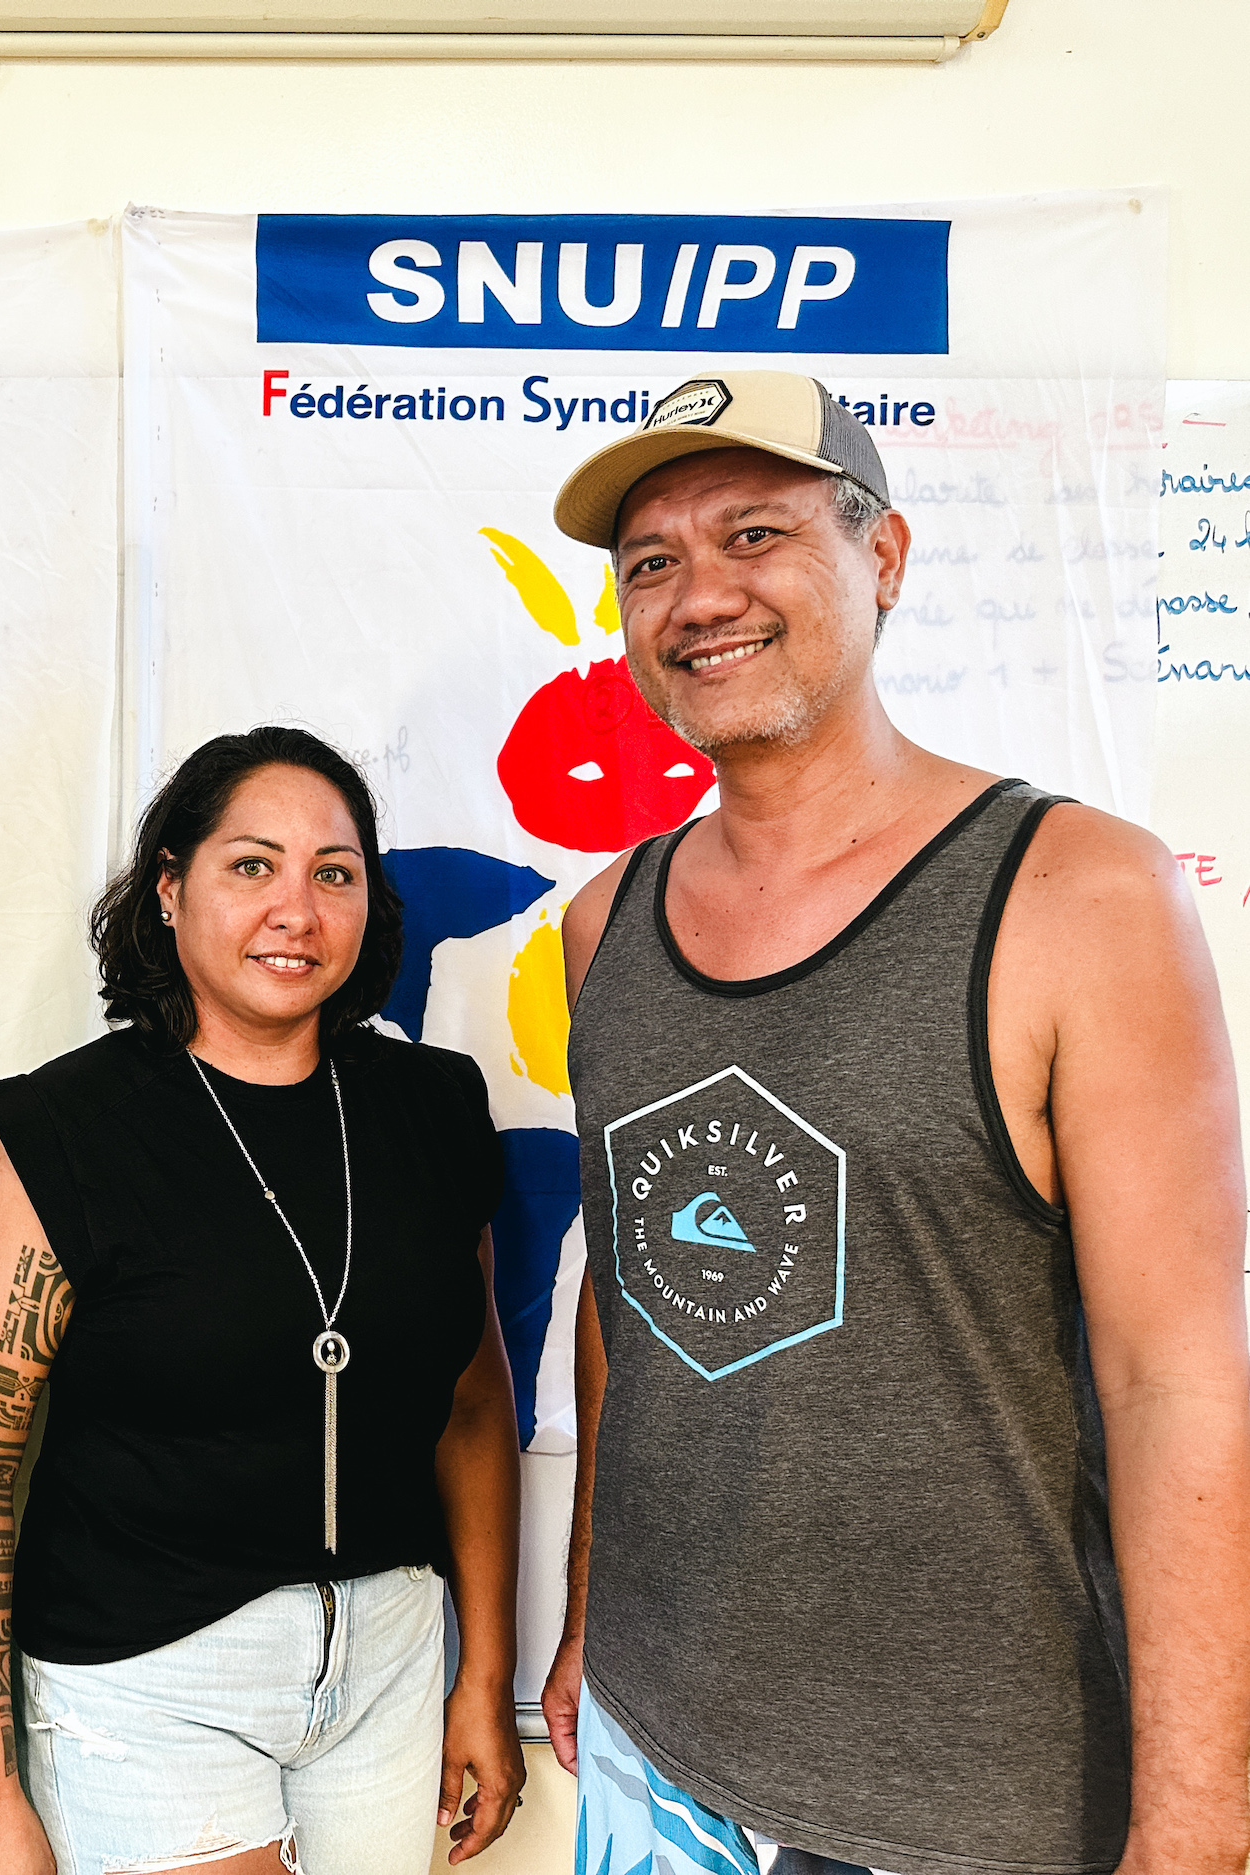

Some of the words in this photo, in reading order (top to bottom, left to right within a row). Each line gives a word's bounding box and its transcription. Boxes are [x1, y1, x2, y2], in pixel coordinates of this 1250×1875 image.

[264, 370, 504, 420] Fédération
[523, 376, 648, 430] Syndi
[652, 401, 699, 427] Hurley
[1188, 517, 1227, 554] 24
[631, 1119, 807, 1225] QUIKSILVER
[709, 1165, 727, 1176] EST.
[635, 1218, 647, 1251] THE
[643, 1258, 727, 1324] MOUNTAIN
[734, 1296, 768, 1324] AND
[767, 1243, 799, 1297] WAVE
[702, 1270, 723, 1282] 1969
